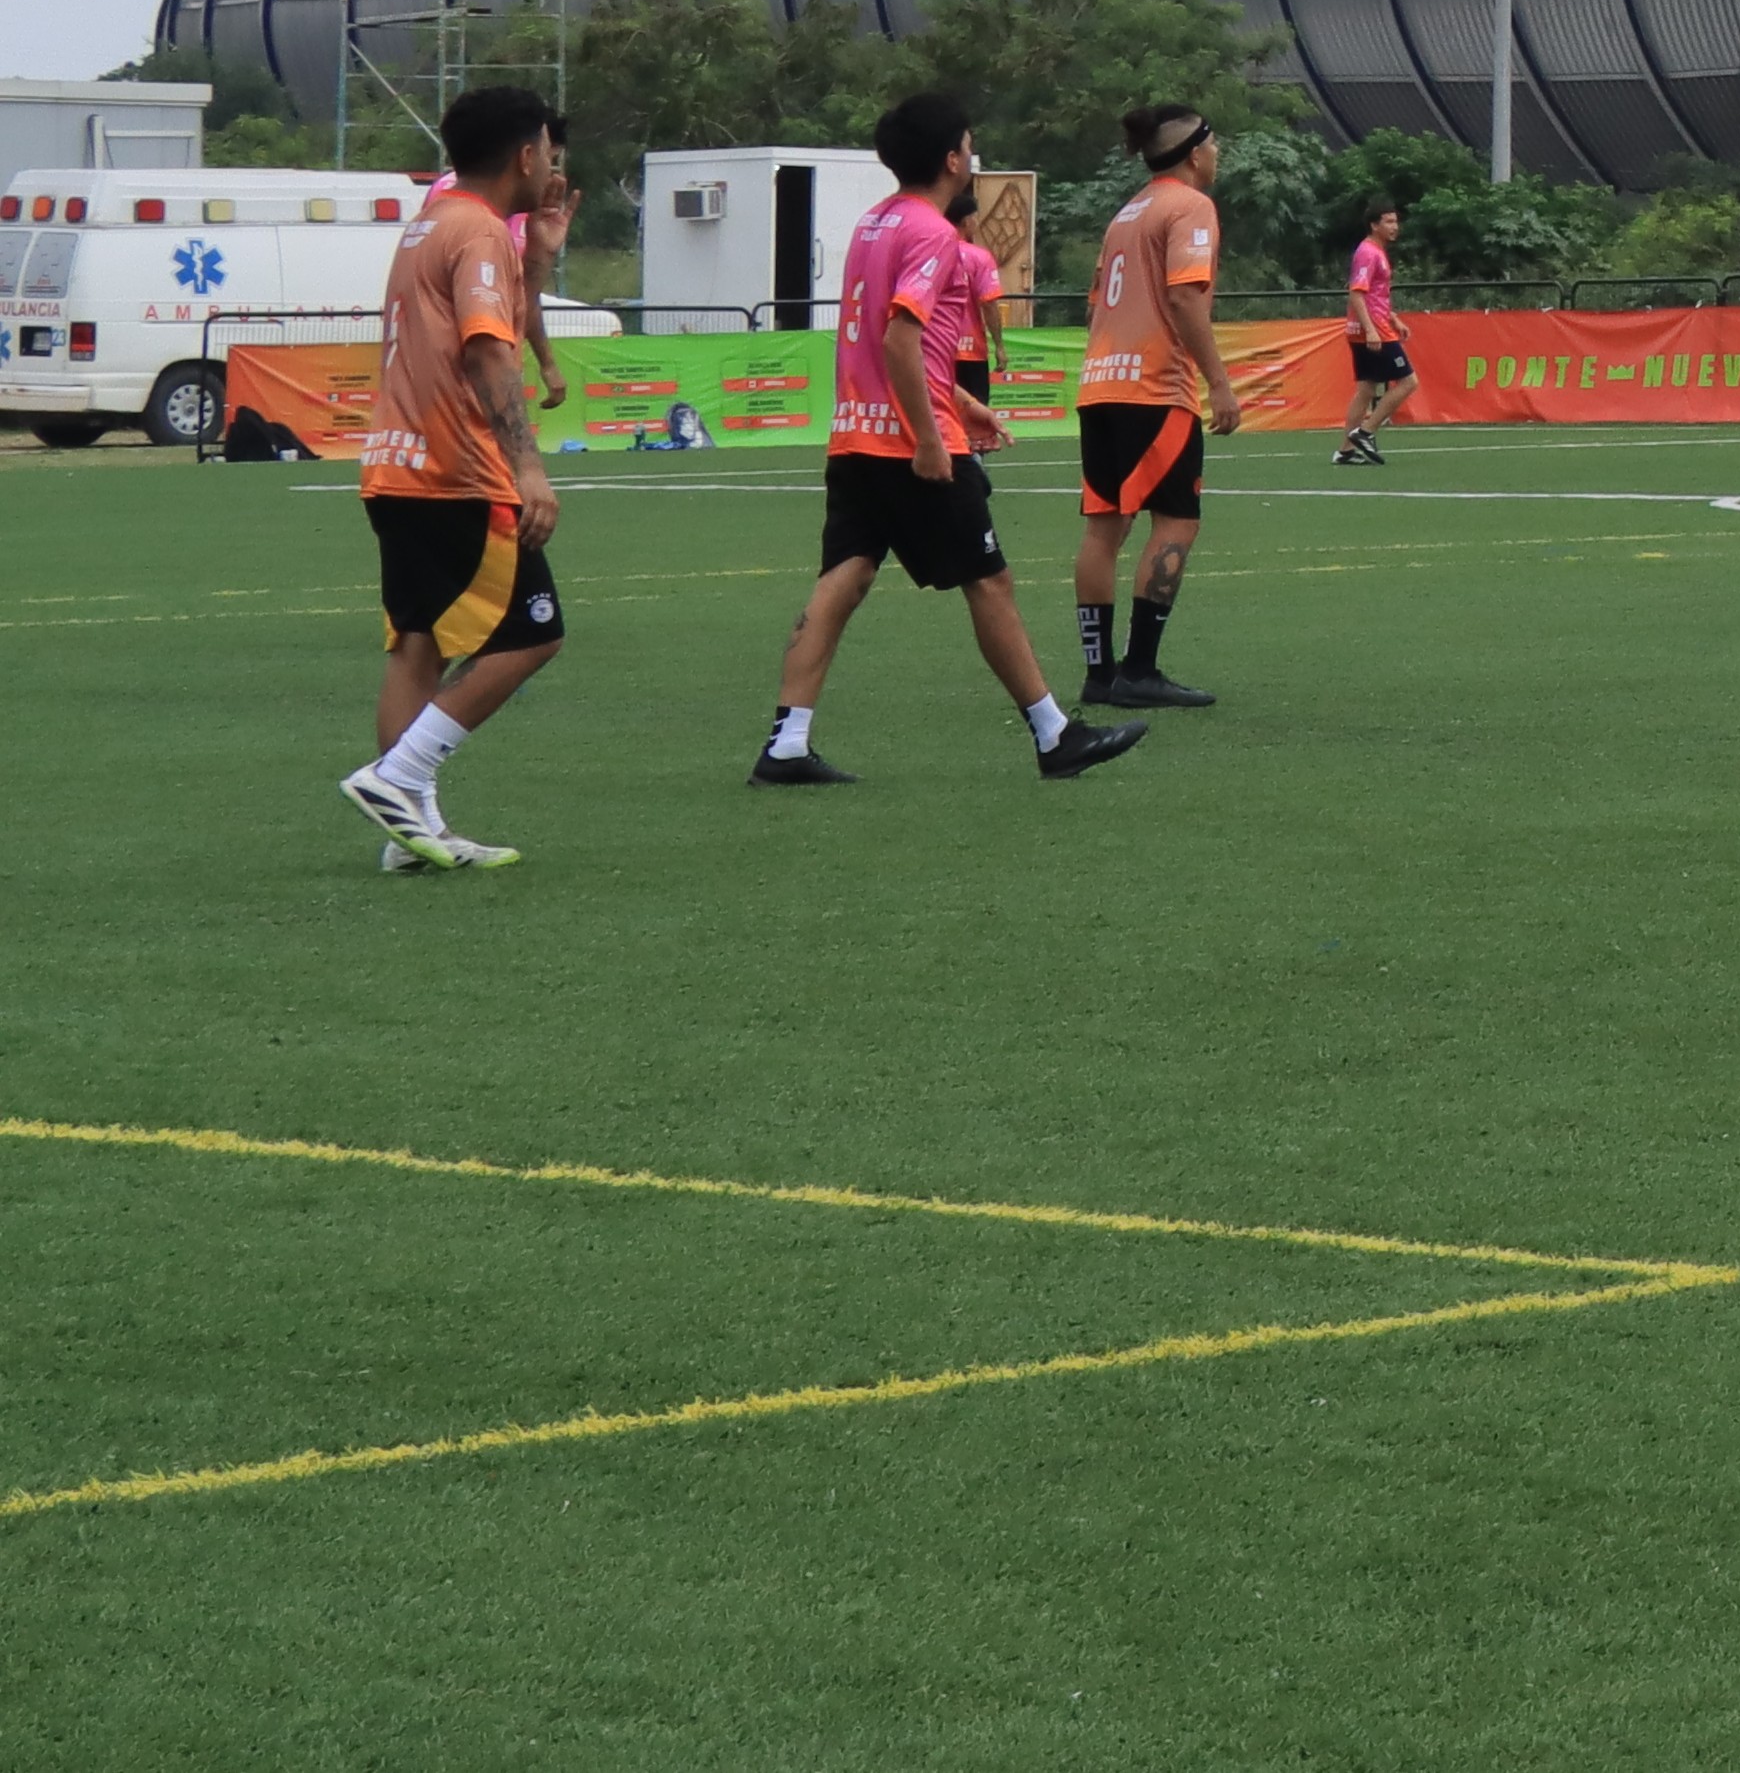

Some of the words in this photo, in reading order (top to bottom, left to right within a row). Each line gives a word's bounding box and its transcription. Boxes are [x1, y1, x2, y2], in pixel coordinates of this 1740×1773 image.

[1106, 253, 1126, 308] 6
[0, 302, 61, 318] ULANCIA
[846, 281, 865, 343] 3
[1465, 354, 1597, 390] PONTE
